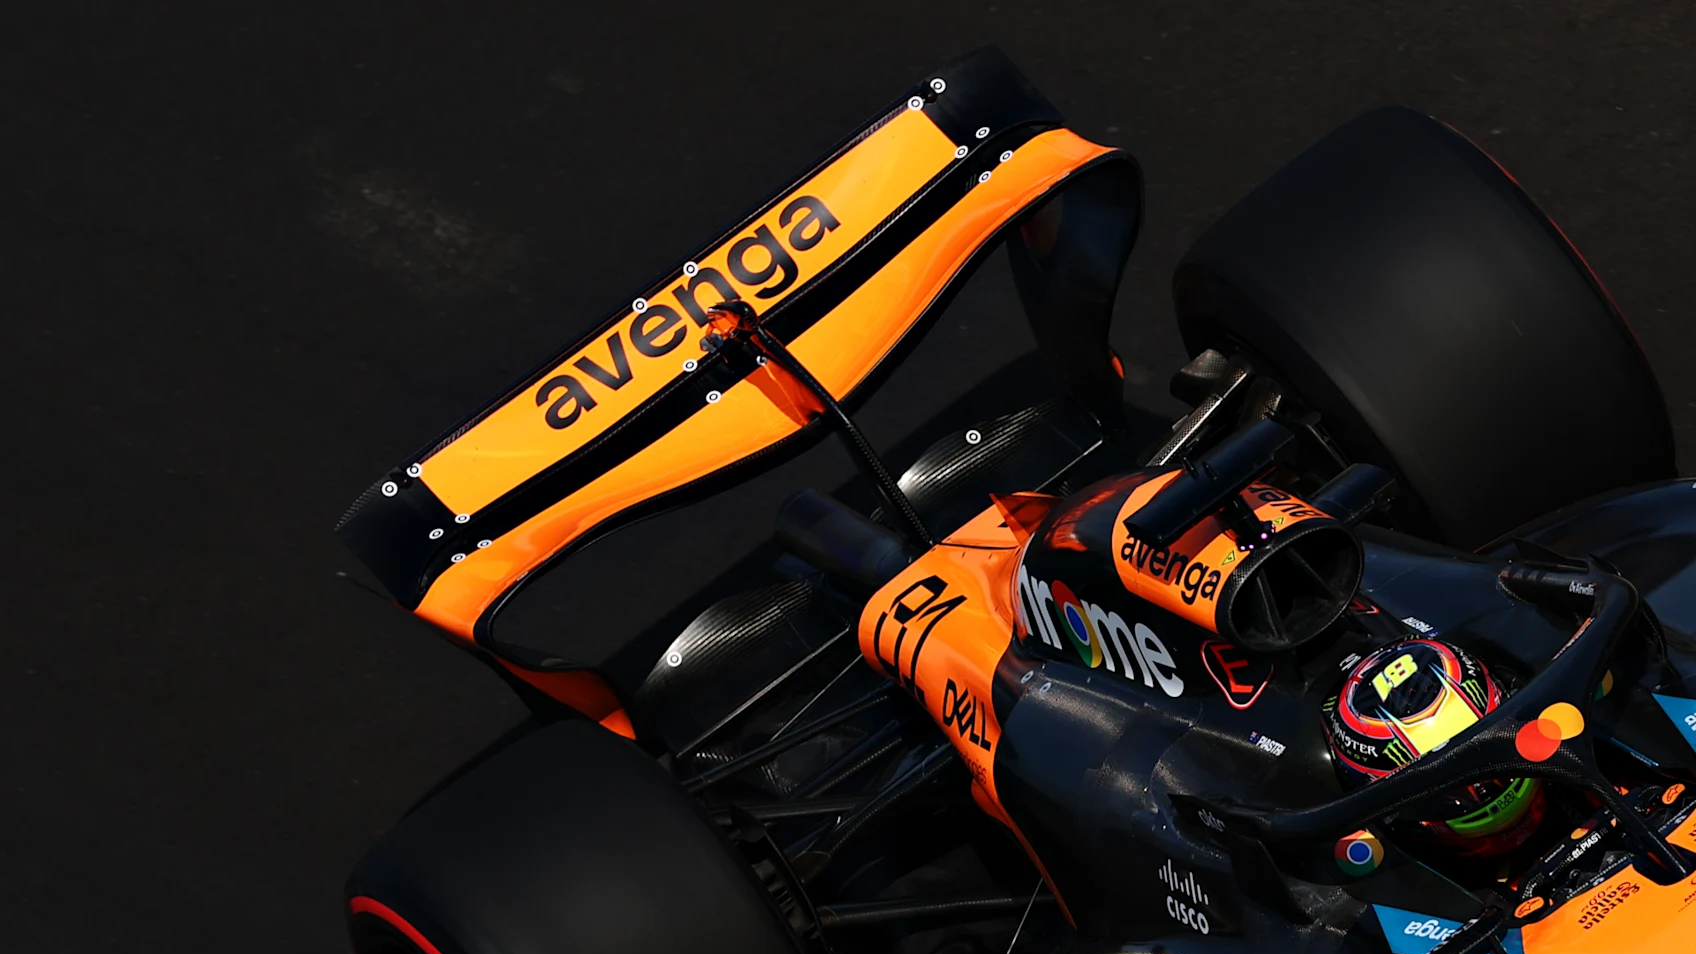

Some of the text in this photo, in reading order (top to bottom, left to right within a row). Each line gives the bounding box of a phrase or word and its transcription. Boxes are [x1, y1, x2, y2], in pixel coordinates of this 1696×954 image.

[534, 194, 842, 431] avenga
[1121, 536, 1221, 605] avenga
[943, 679, 991, 752] DELL
[1166, 895, 1210, 935] CISCO
[1583, 883, 1640, 930] Estrella
